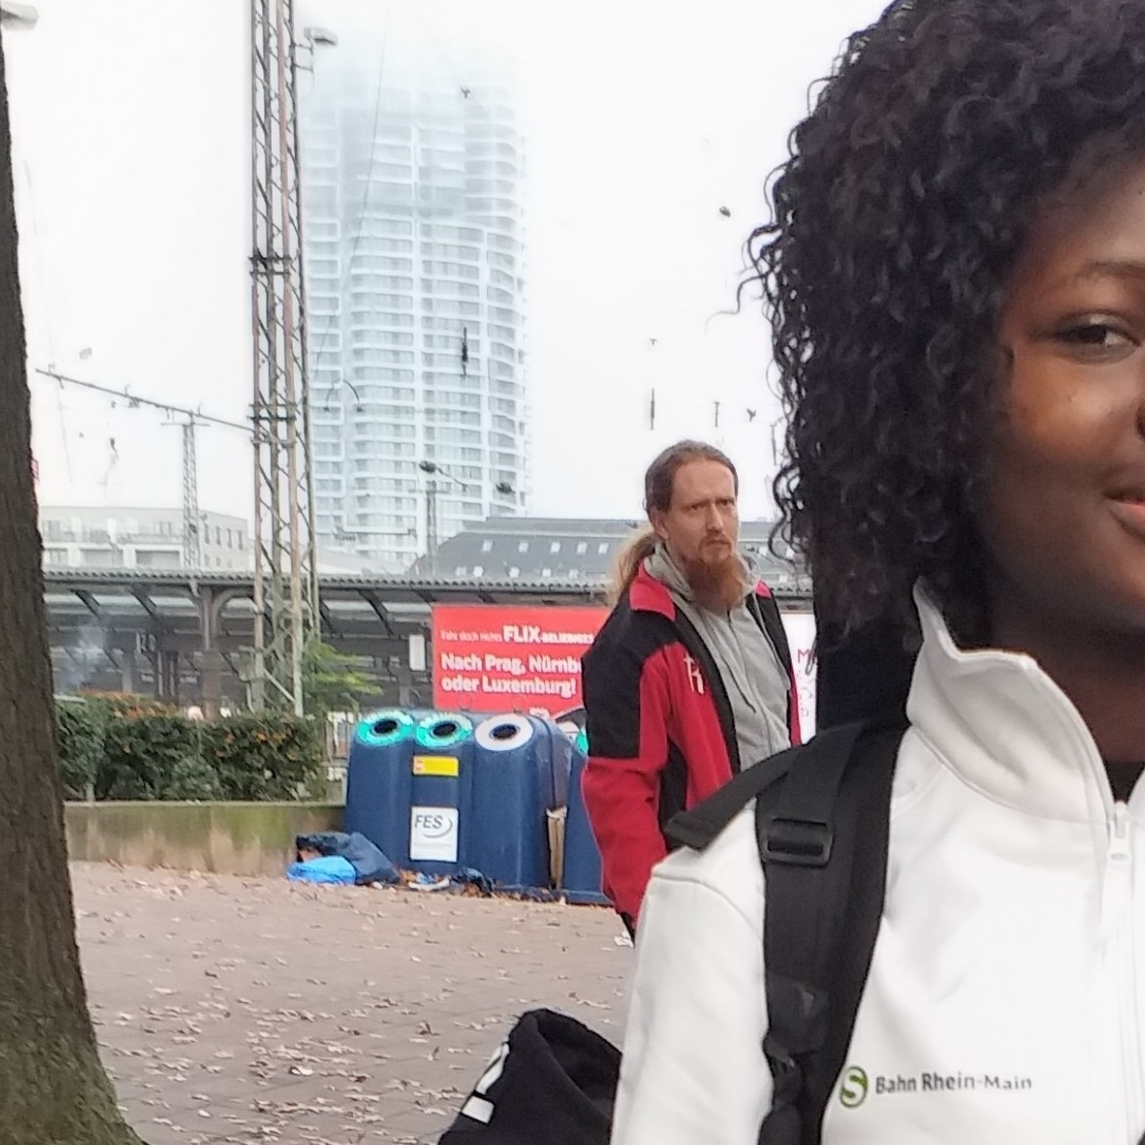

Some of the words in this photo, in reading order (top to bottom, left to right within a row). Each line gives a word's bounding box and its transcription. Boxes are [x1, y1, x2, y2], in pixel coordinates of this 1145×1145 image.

[440, 653, 482, 671] Nach
[484, 653, 526, 675] Prag,
[441, 674, 480, 692] oder
[482, 675, 577, 699] Luxemburg!
[414, 814, 444, 829] FES
[875, 1074, 917, 1095] Bahn
[921, 1071, 1033, 1091] Rhein-Main
